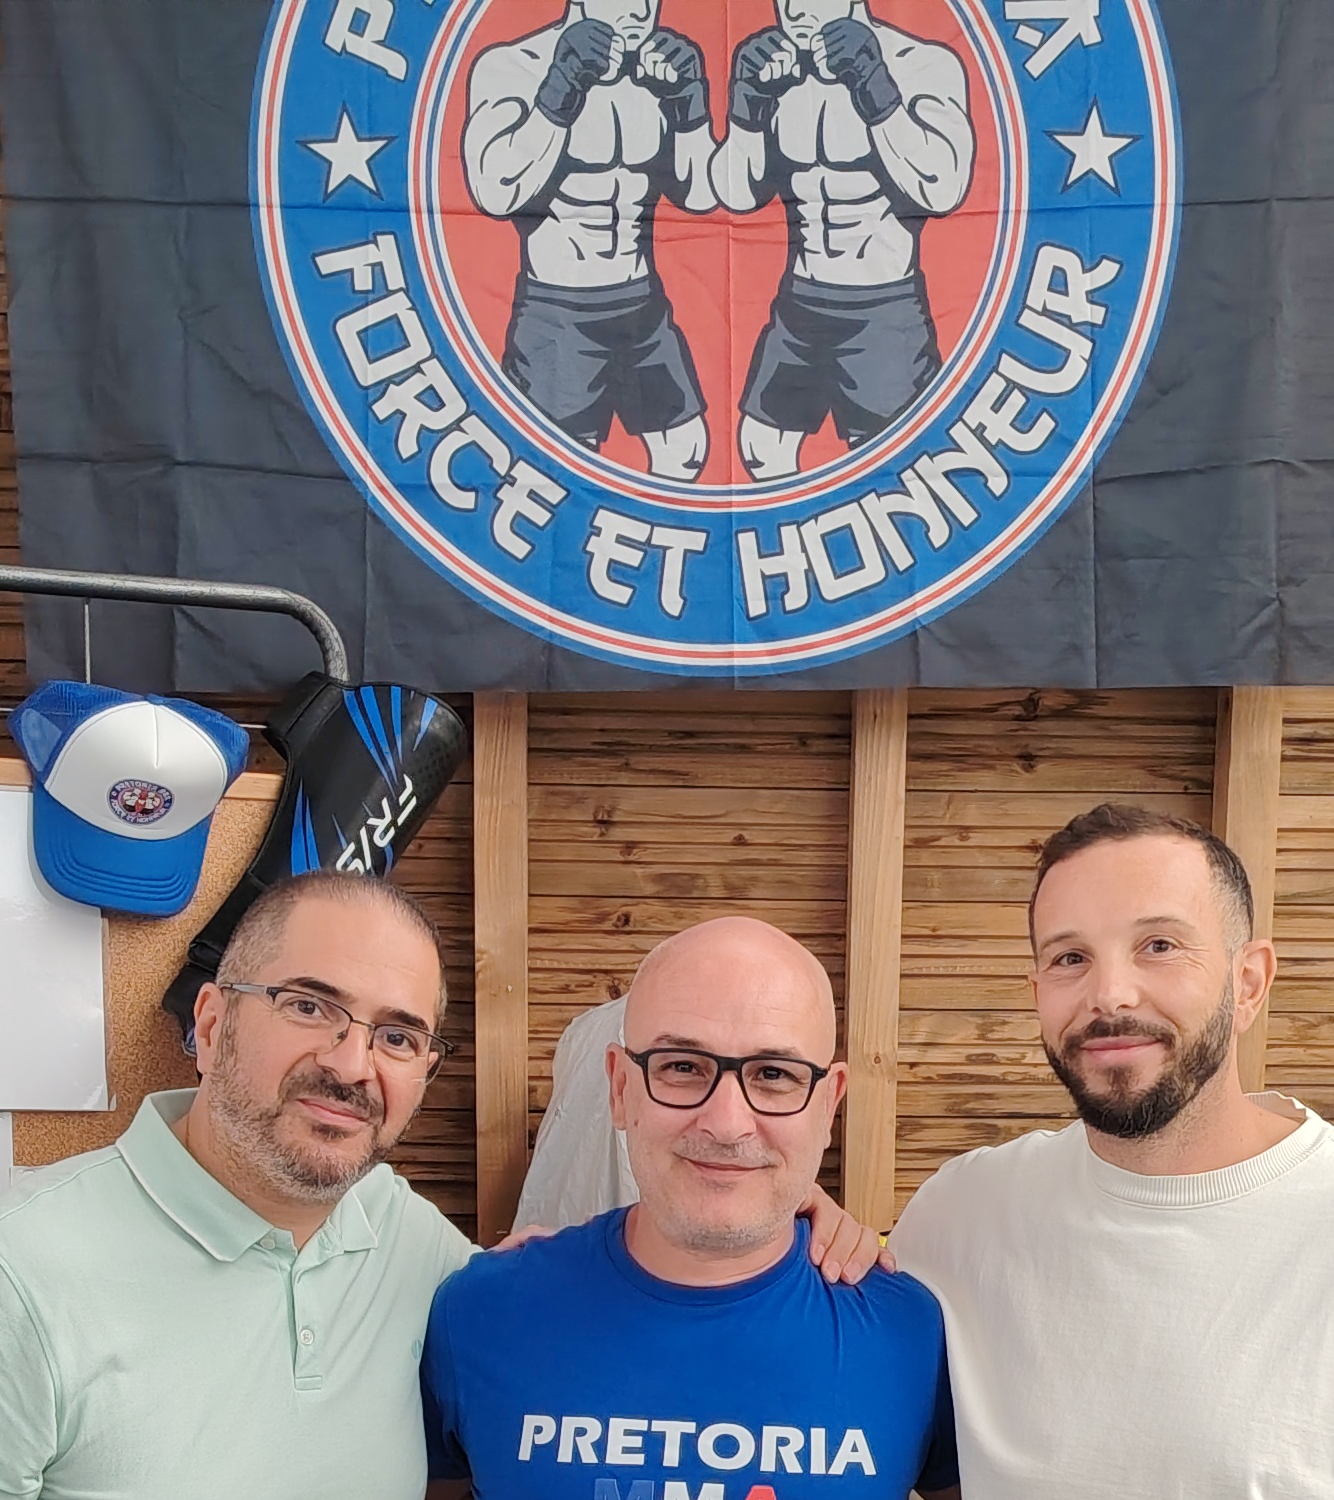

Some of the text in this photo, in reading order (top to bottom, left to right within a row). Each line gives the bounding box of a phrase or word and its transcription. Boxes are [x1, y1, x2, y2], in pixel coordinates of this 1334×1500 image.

[315, 231, 1125, 621] FORCE ET HONNEUR
[518, 1414, 877, 1476] PRETORIA
